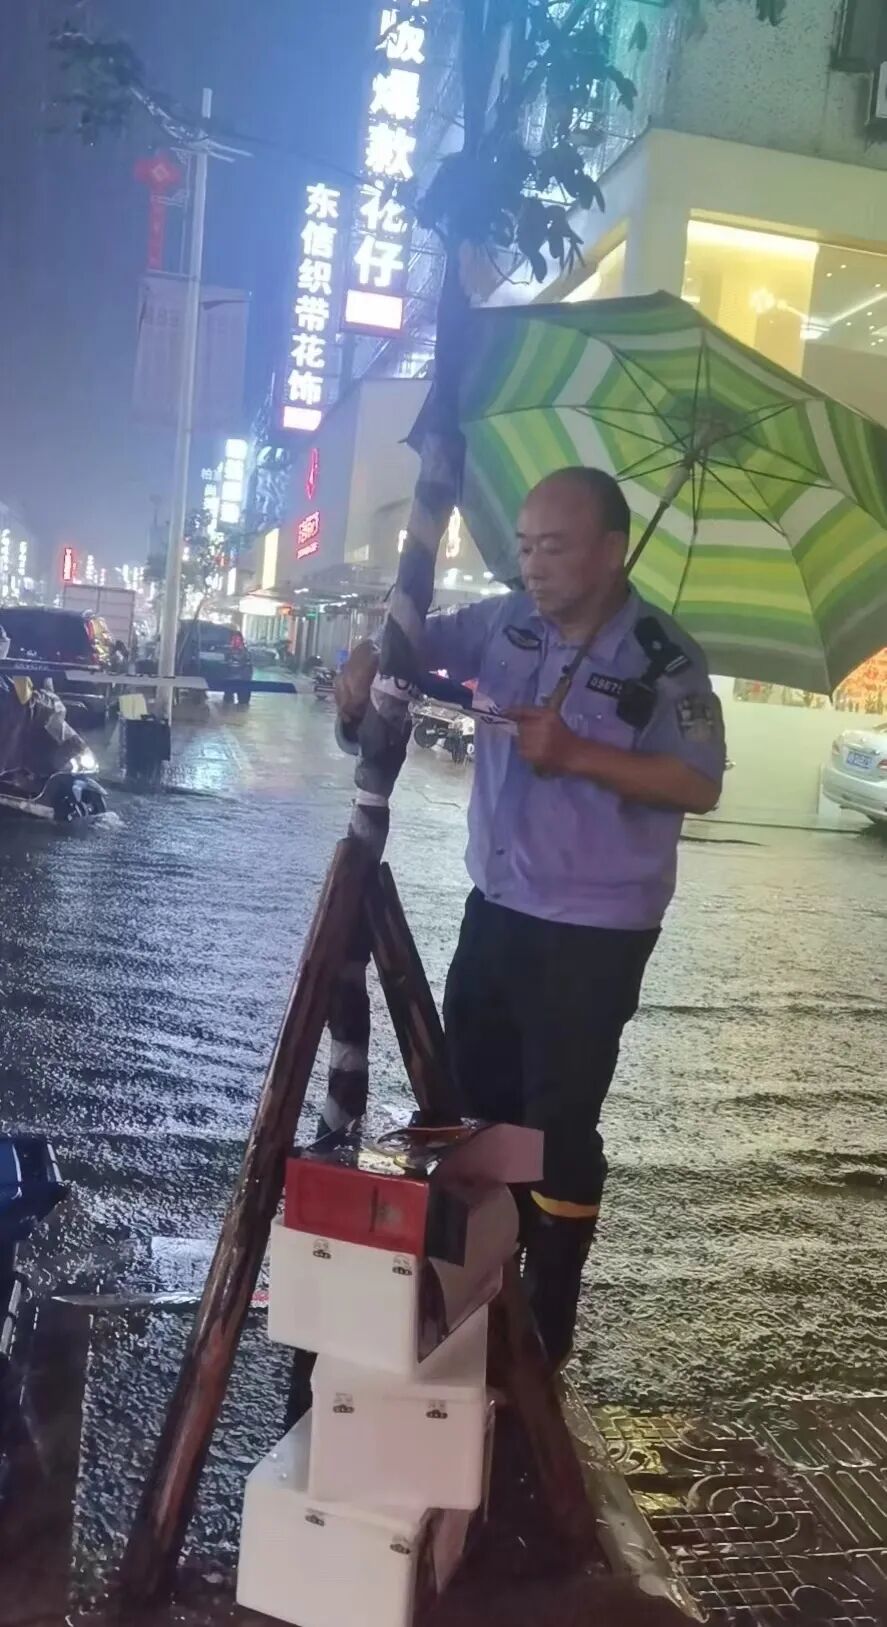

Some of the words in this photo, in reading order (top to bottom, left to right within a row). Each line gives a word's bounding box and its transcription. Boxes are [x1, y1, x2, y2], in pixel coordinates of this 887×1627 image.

[288, 183, 341, 405] 东信织带花饰
